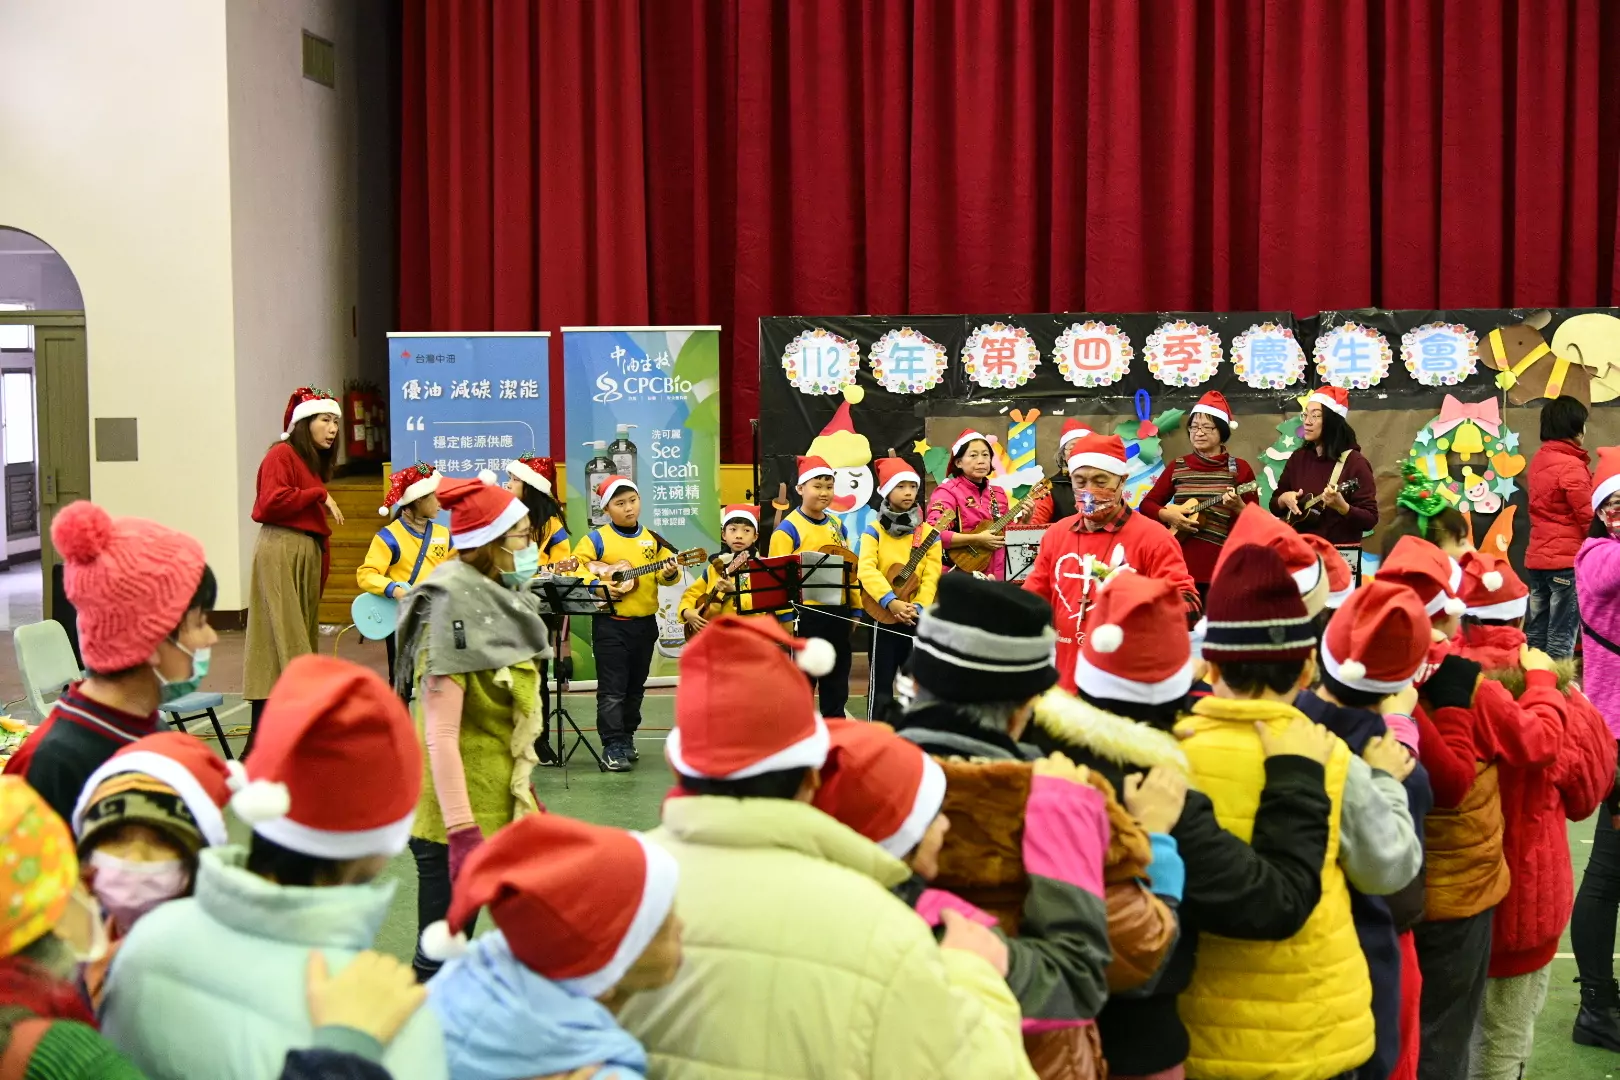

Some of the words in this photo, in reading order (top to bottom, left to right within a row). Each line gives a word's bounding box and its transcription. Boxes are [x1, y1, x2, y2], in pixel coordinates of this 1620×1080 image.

[416, 354, 455, 364] 台灣中油
[611, 346, 670, 374] 中油生技
[402, 379, 442, 400] 優油
[451, 379, 491, 399] 減碳
[500, 379, 539, 399] 潔能
[624, 375, 692, 394] CPCBio
[433, 435, 513, 449] 穩定能源供應
[651, 442, 680, 458] See
[652, 461, 698, 478] Clean
[653, 485, 699, 500] 洗碗精
